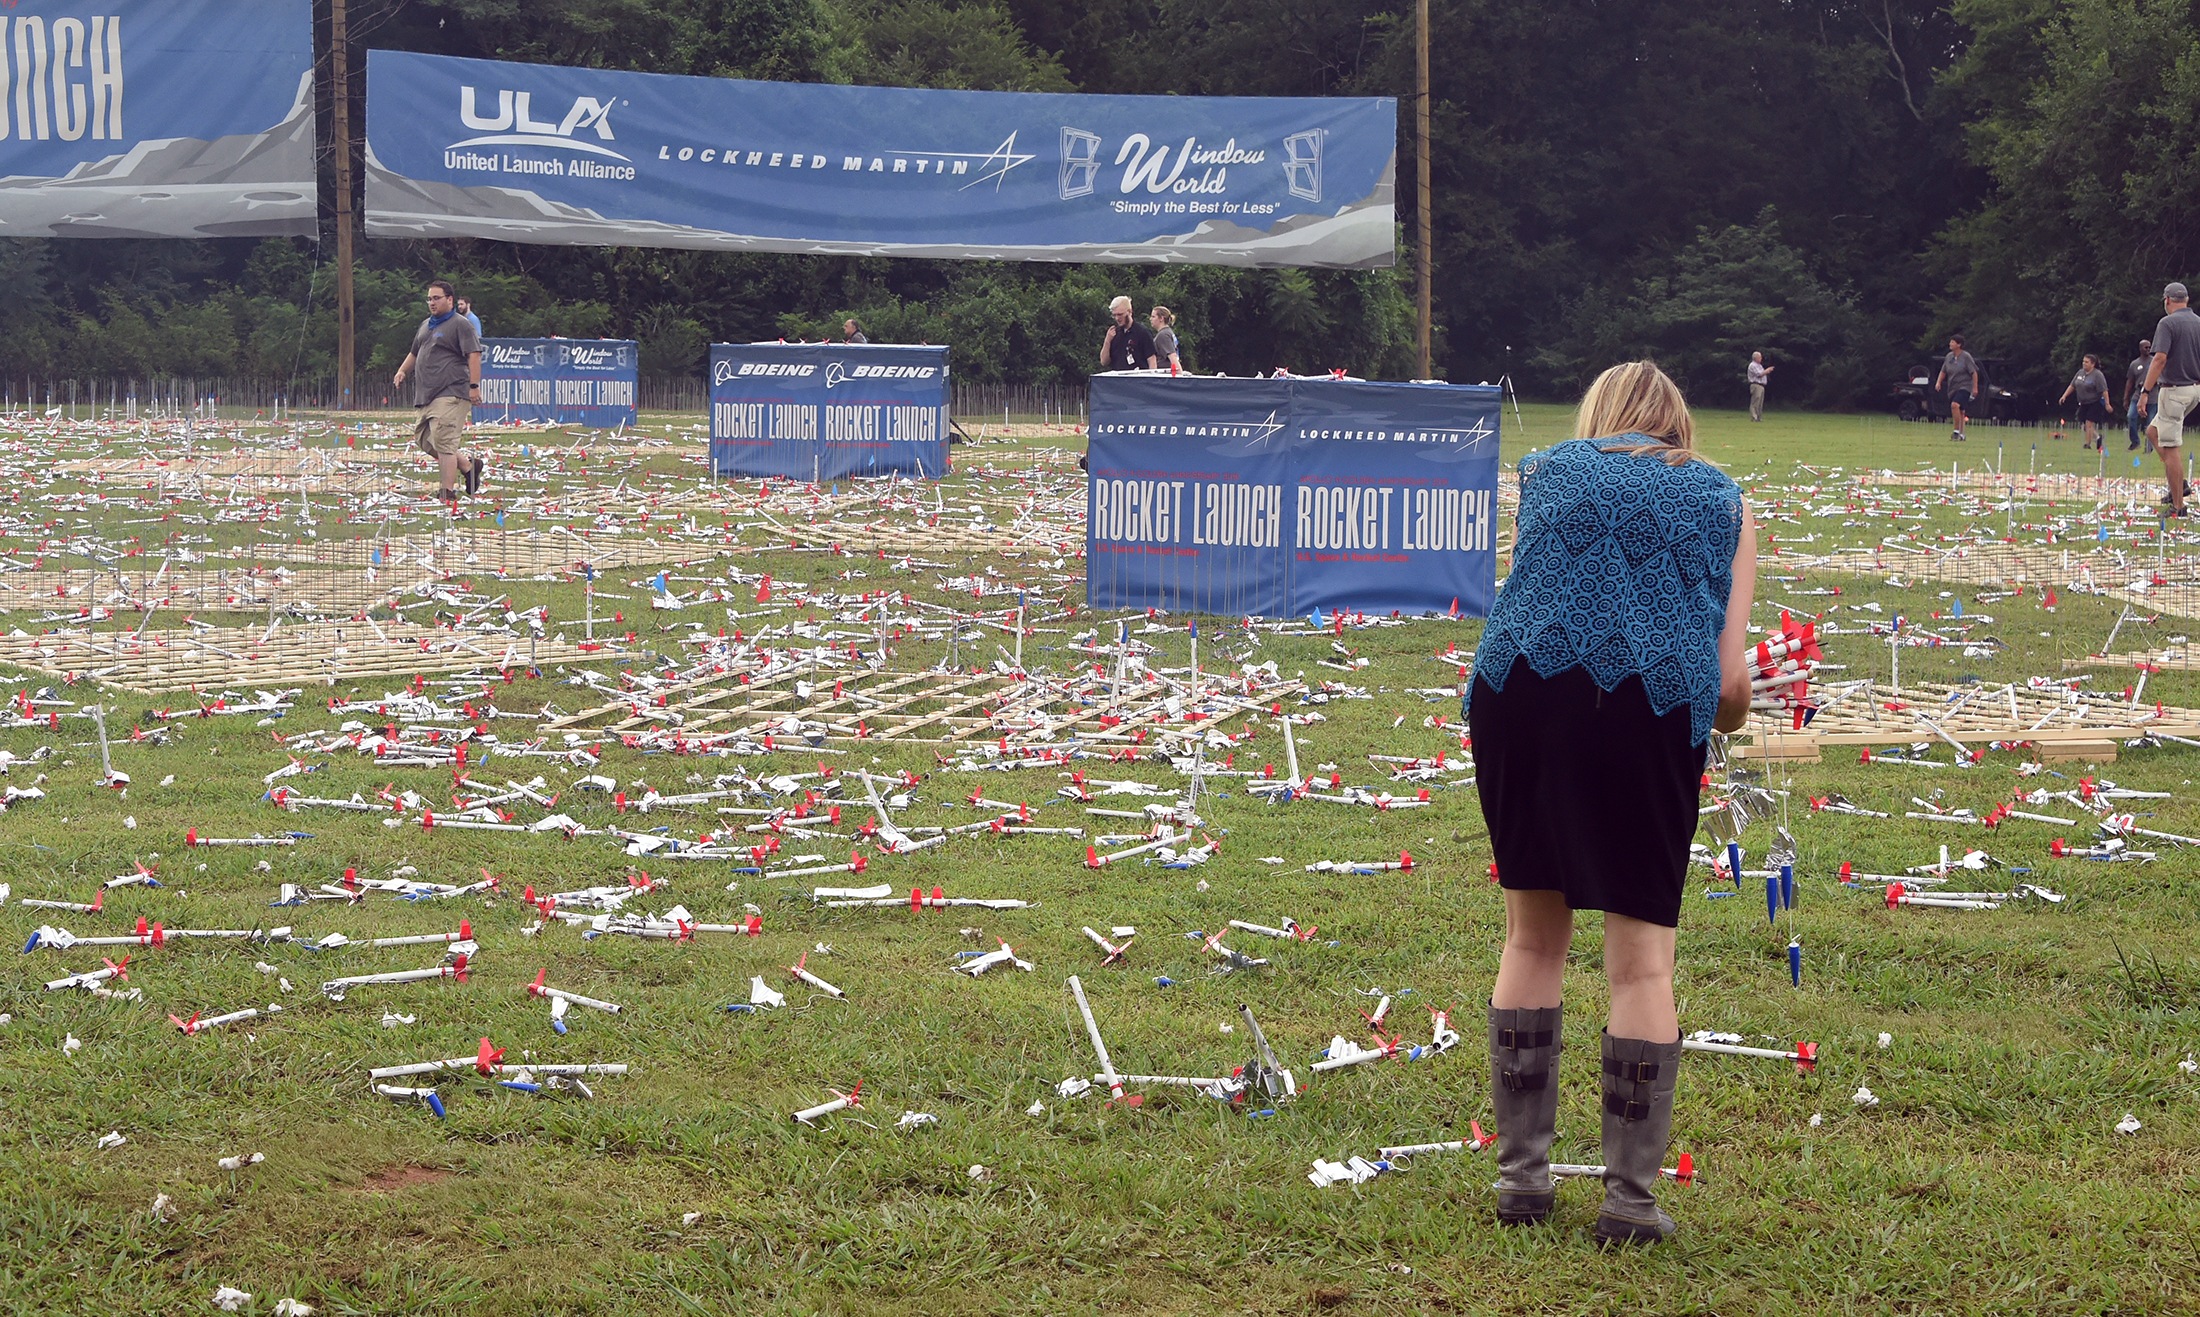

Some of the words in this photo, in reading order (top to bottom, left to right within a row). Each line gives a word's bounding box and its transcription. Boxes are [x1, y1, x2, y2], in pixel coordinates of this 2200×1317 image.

[460, 86, 617, 140] ULA
[444, 151, 498, 171] United
[503, 154, 564, 176] Launch
[568, 160, 636, 180] Alliance
[659, 145, 826, 169] LOCKHEED
[843, 156, 969, 174] MARTIN
[1114, 133, 1265, 193] Window
[1109, 200, 1162, 215] "Simply
[1164, 201, 1186, 213] the
[1189, 201, 1220, 213] Best
[1221, 201, 1240, 213] for
[1243, 202, 1280, 214] Less"
[491, 344, 531, 363] Window
[571, 346, 613, 364] Window
[737, 363, 815, 377] BOEING
[851, 365, 936, 379] BOEING
[480, 379, 512, 405] OCKET
[1098, 424, 1178, 436] LOCKHEED
[1185, 426, 1251, 438] MARTIN
[1300, 430, 1386, 441] LOCKHEED
[1393, 432, 1459, 443] MARTIN
[1097, 468, 1128, 477] APOLLO
[1136, 470, 1168, 478] GOLDEN
[1169, 471, 1220, 480] ANNIVERSARY
[1222, 472, 1240, 481] 2019
[1299, 475, 1332, 484] APOLLO
[1342, 476, 1375, 485] GOLDEN
[1377, 477, 1430, 486] ANNIVERSARY
[1432, 478, 1448, 486] 2019
[1095, 542, 1109, 552] U.S.
[1111, 544, 1135, 554] Space
[1136, 544, 1143, 554] &
[1145, 545, 1172, 555] Rocket
[1296, 552, 1312, 562] U.S.
[1315, 552, 1340, 563] Space
[1342, 552, 1349, 562] &
[1351, 552, 1380, 562] Rocket
